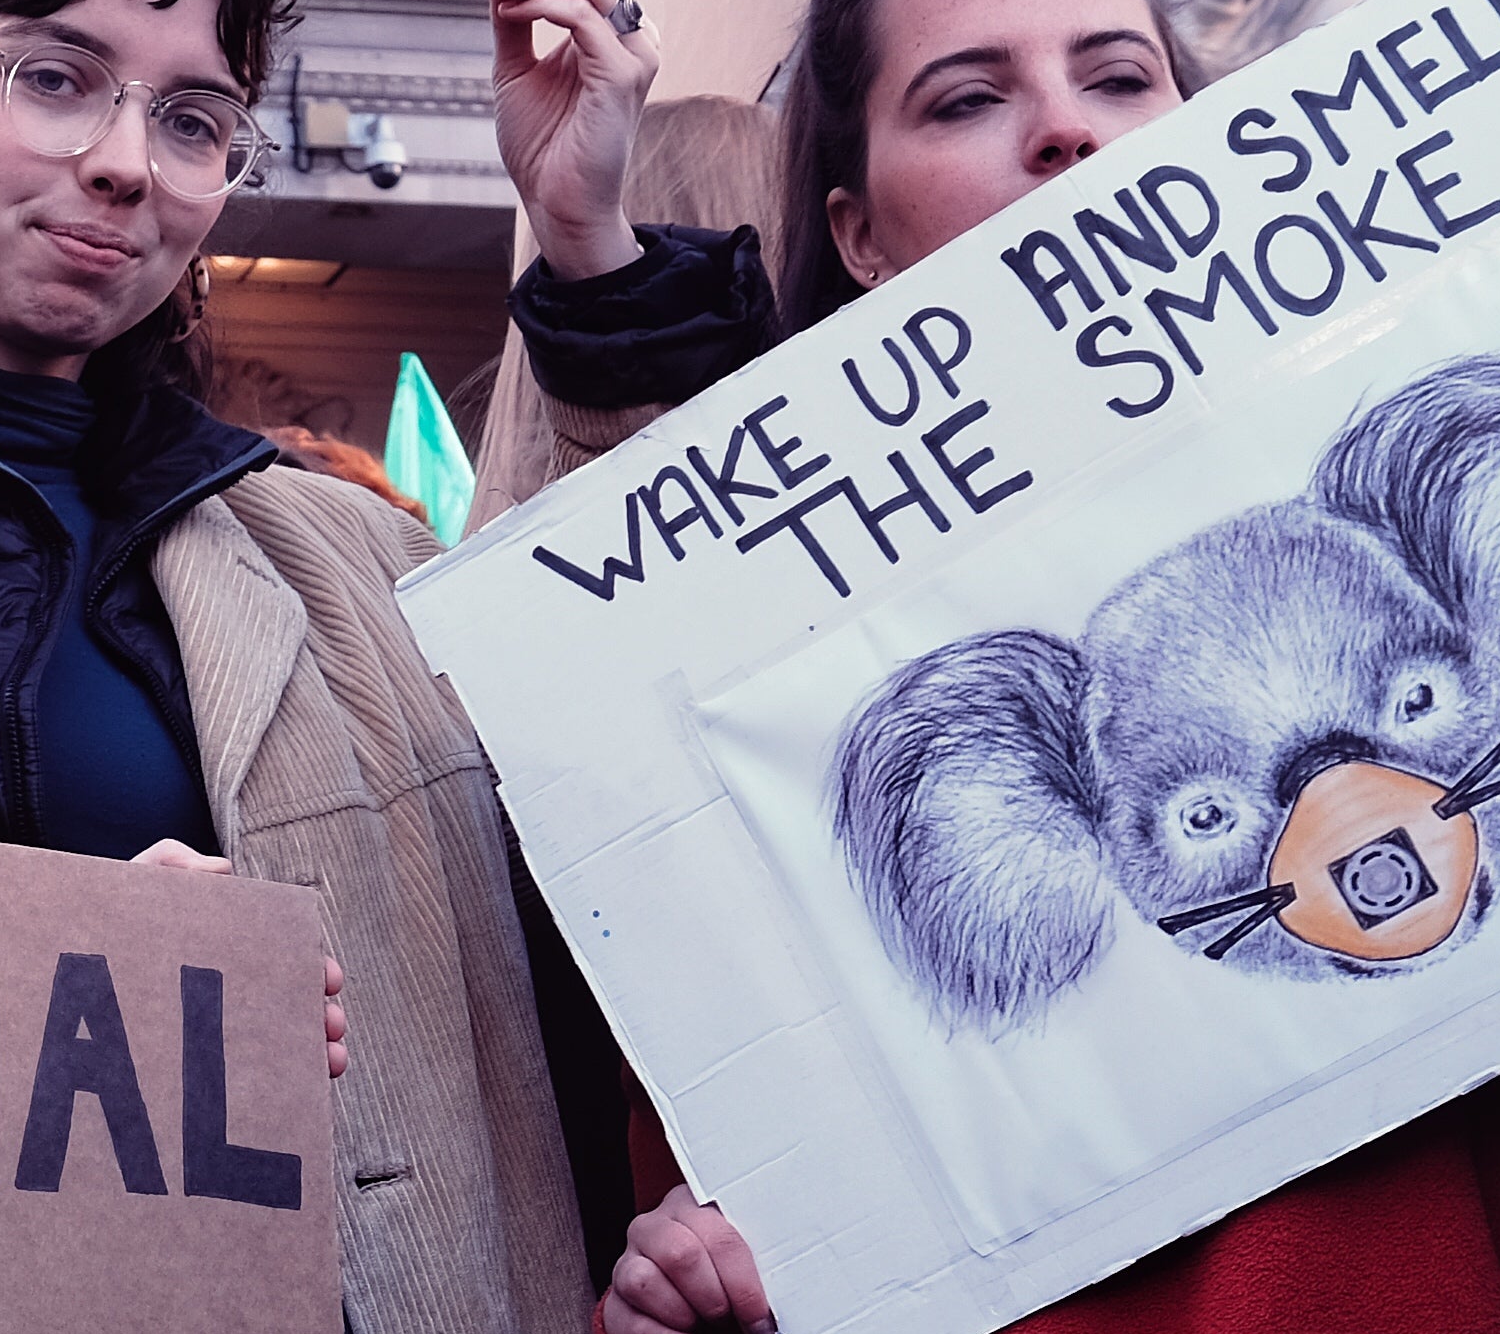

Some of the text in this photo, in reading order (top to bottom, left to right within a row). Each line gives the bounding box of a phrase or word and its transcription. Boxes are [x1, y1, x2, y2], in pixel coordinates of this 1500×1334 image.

[531, 394, 830, 604] WAKE
[842, 303, 974, 430] UP
[1001, 162, 1221, 334] AND
[735, 398, 1033, 598] THE
